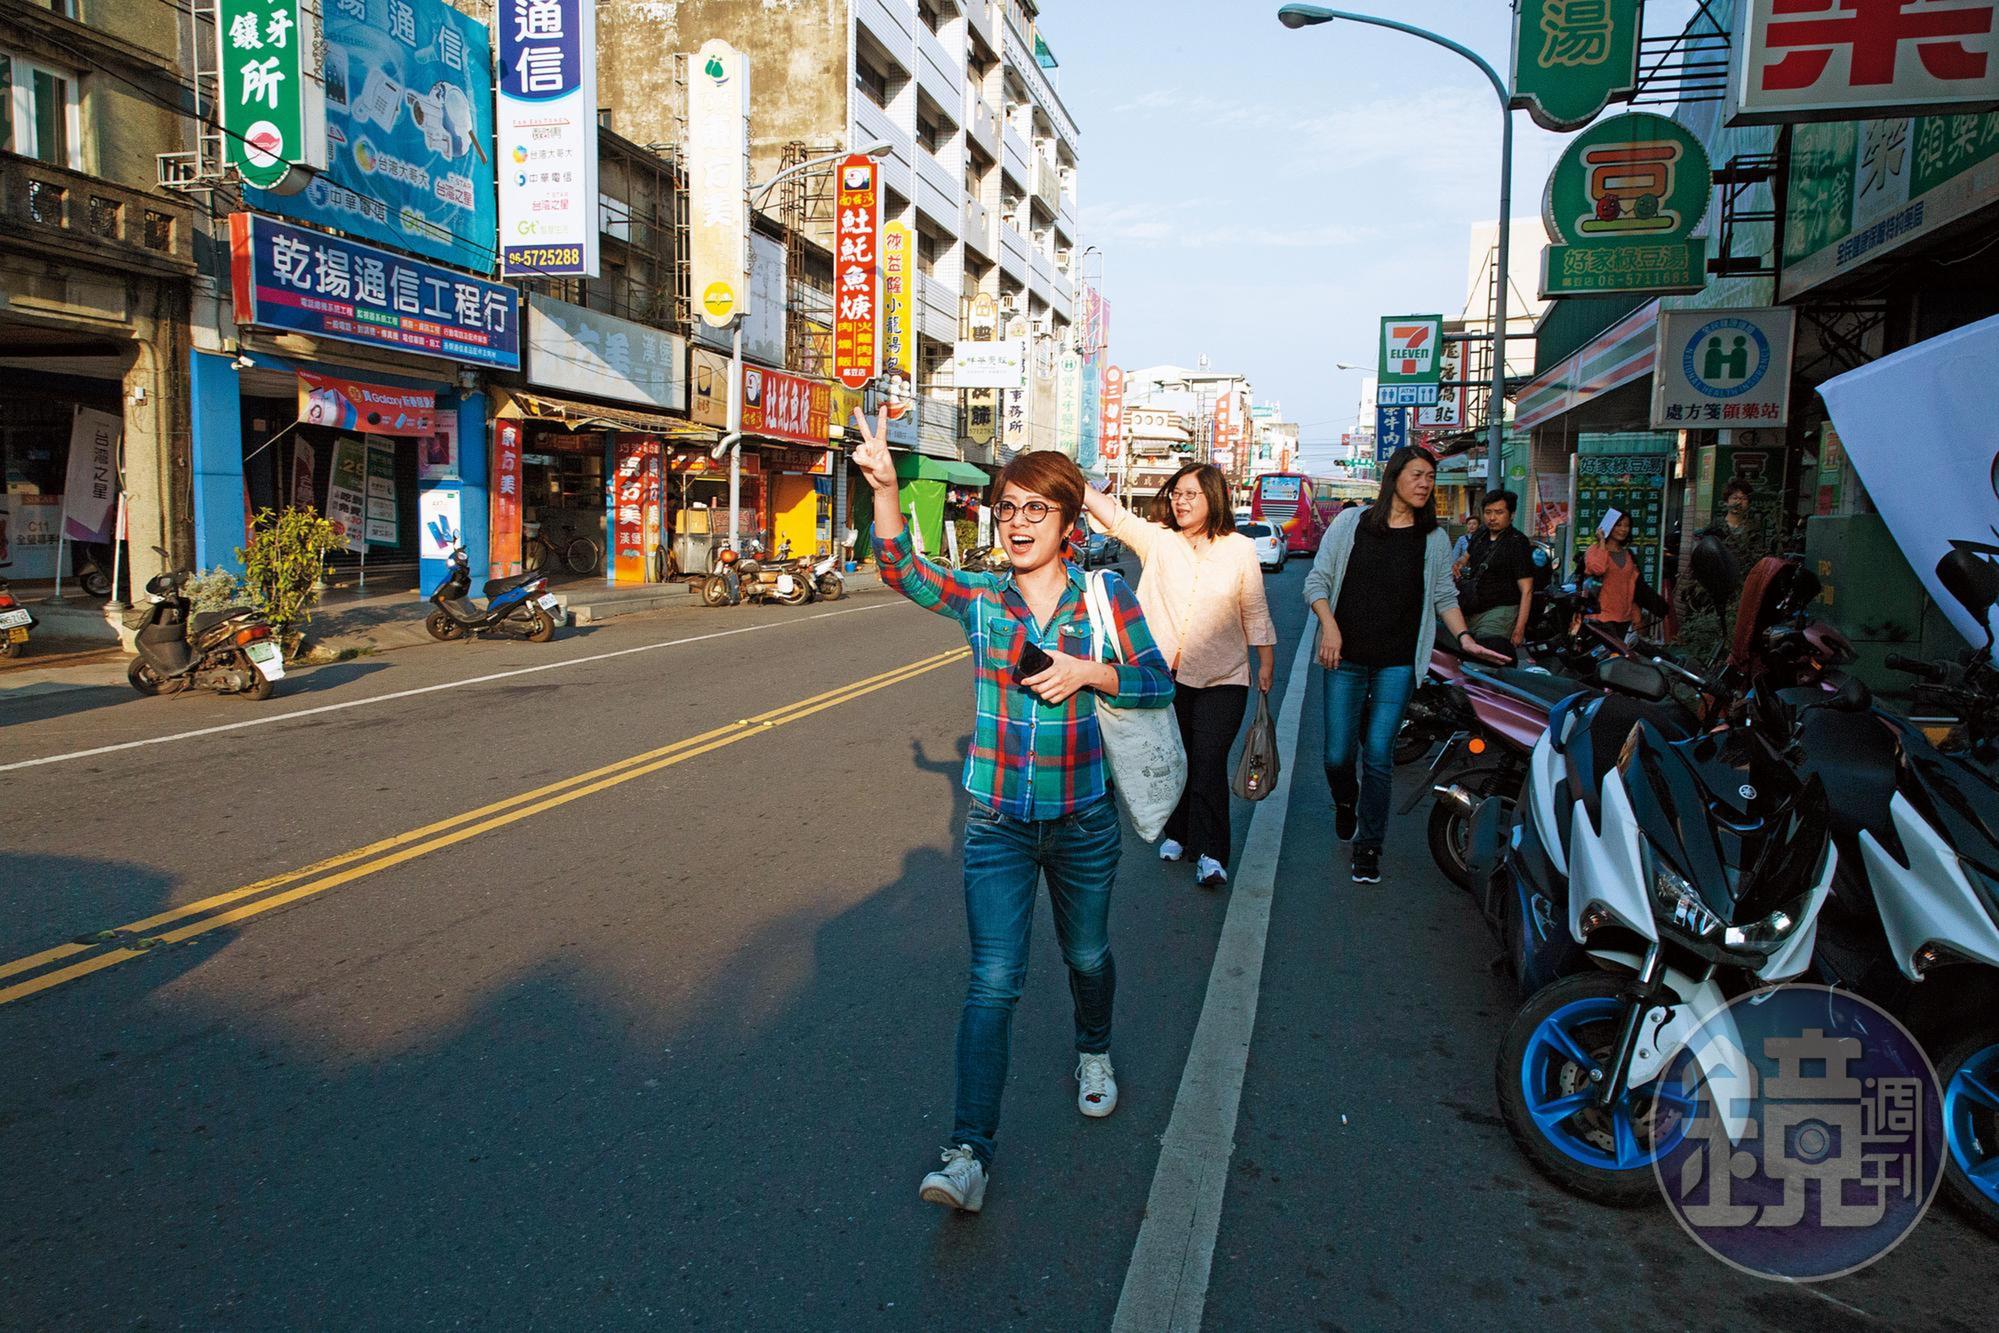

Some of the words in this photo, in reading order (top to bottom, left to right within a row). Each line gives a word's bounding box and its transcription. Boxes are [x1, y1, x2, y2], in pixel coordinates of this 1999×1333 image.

[508, 247, 580, 266] 06-5725288
[1563, 245, 1688, 274] 好家綠豆湯
[271, 234, 509, 333] 乾揚通信工程行
[1599, 271, 1689, 286] 06-5711683
[1665, 403, 1780, 420] 處方箋領藥站
